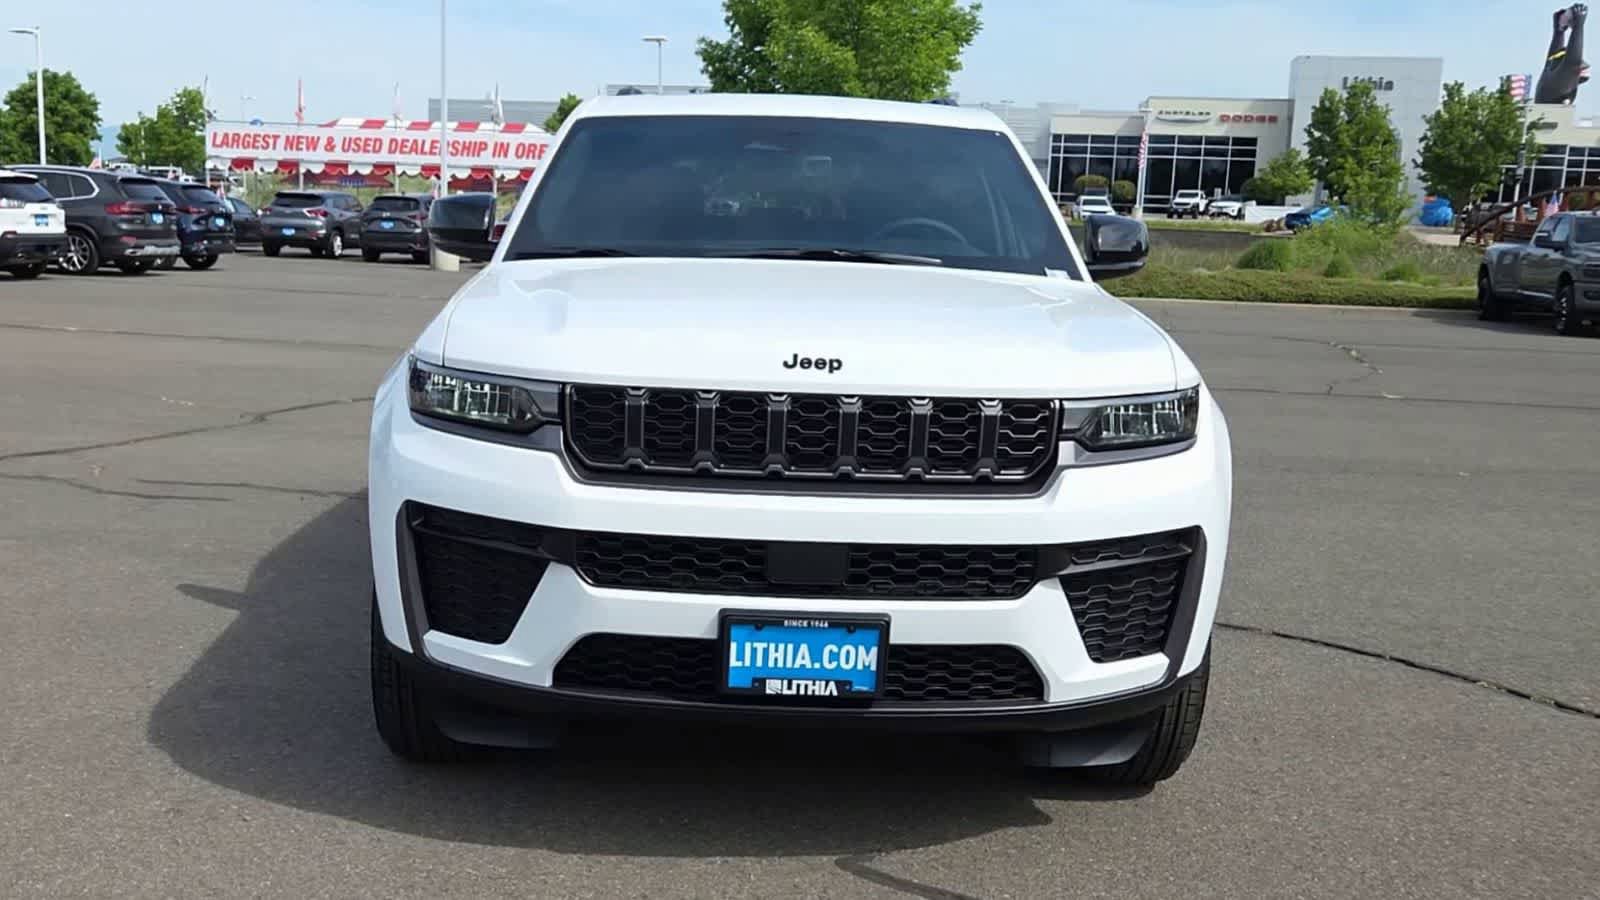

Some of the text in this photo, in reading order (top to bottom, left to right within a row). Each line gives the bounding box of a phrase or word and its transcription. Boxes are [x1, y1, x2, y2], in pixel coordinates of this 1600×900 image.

[1342, 76, 1394, 91] Lihia
[1219, 114, 1278, 123] DODGE
[211, 131, 281, 151] LARGEST
[284, 134, 320, 151] NEW
[324, 136, 337, 152] &
[341, 137, 383, 154] USED
[388, 138, 488, 158] DEALESHIP
[492, 142, 510, 158] IN
[782, 353, 843, 374] Jeep
[783, 619, 808, 628] SINCE
[729, 641, 878, 672] LITHIA.COM
[782, 679, 838, 696] LITHIA
